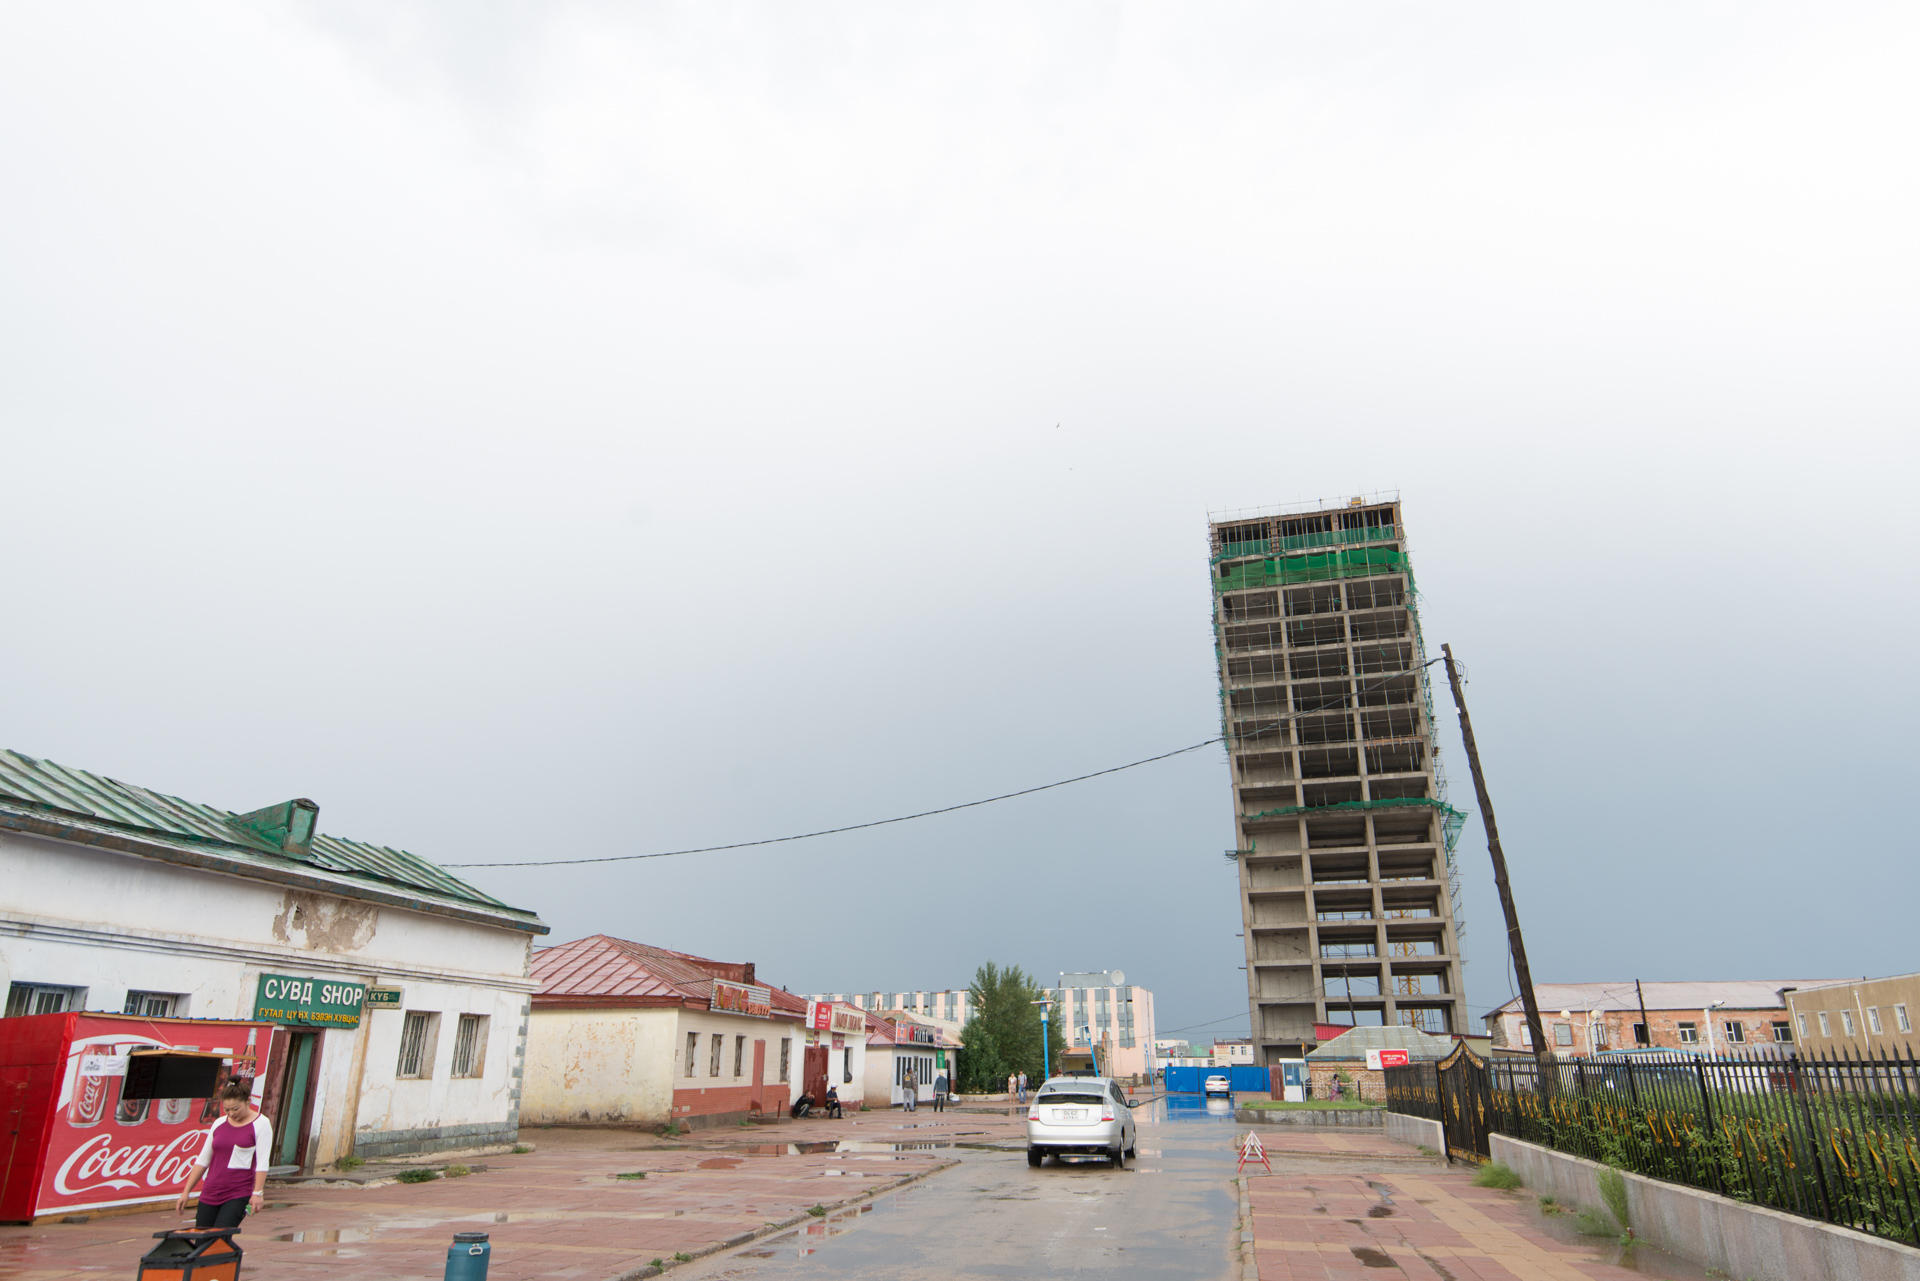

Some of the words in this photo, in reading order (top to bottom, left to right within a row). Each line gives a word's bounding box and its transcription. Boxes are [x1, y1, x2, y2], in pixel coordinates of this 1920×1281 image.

[264, 979, 313, 1005] СУВД
[320, 985, 363, 1006] SHOP
[258, 1008, 283, 1018] ГУТАЛ
[311, 1012, 333, 1022] БЭЛЭН
[333, 1013, 359, 1024] ХУВЦАС
[54, 1129, 210, 1195] Coca-Co
